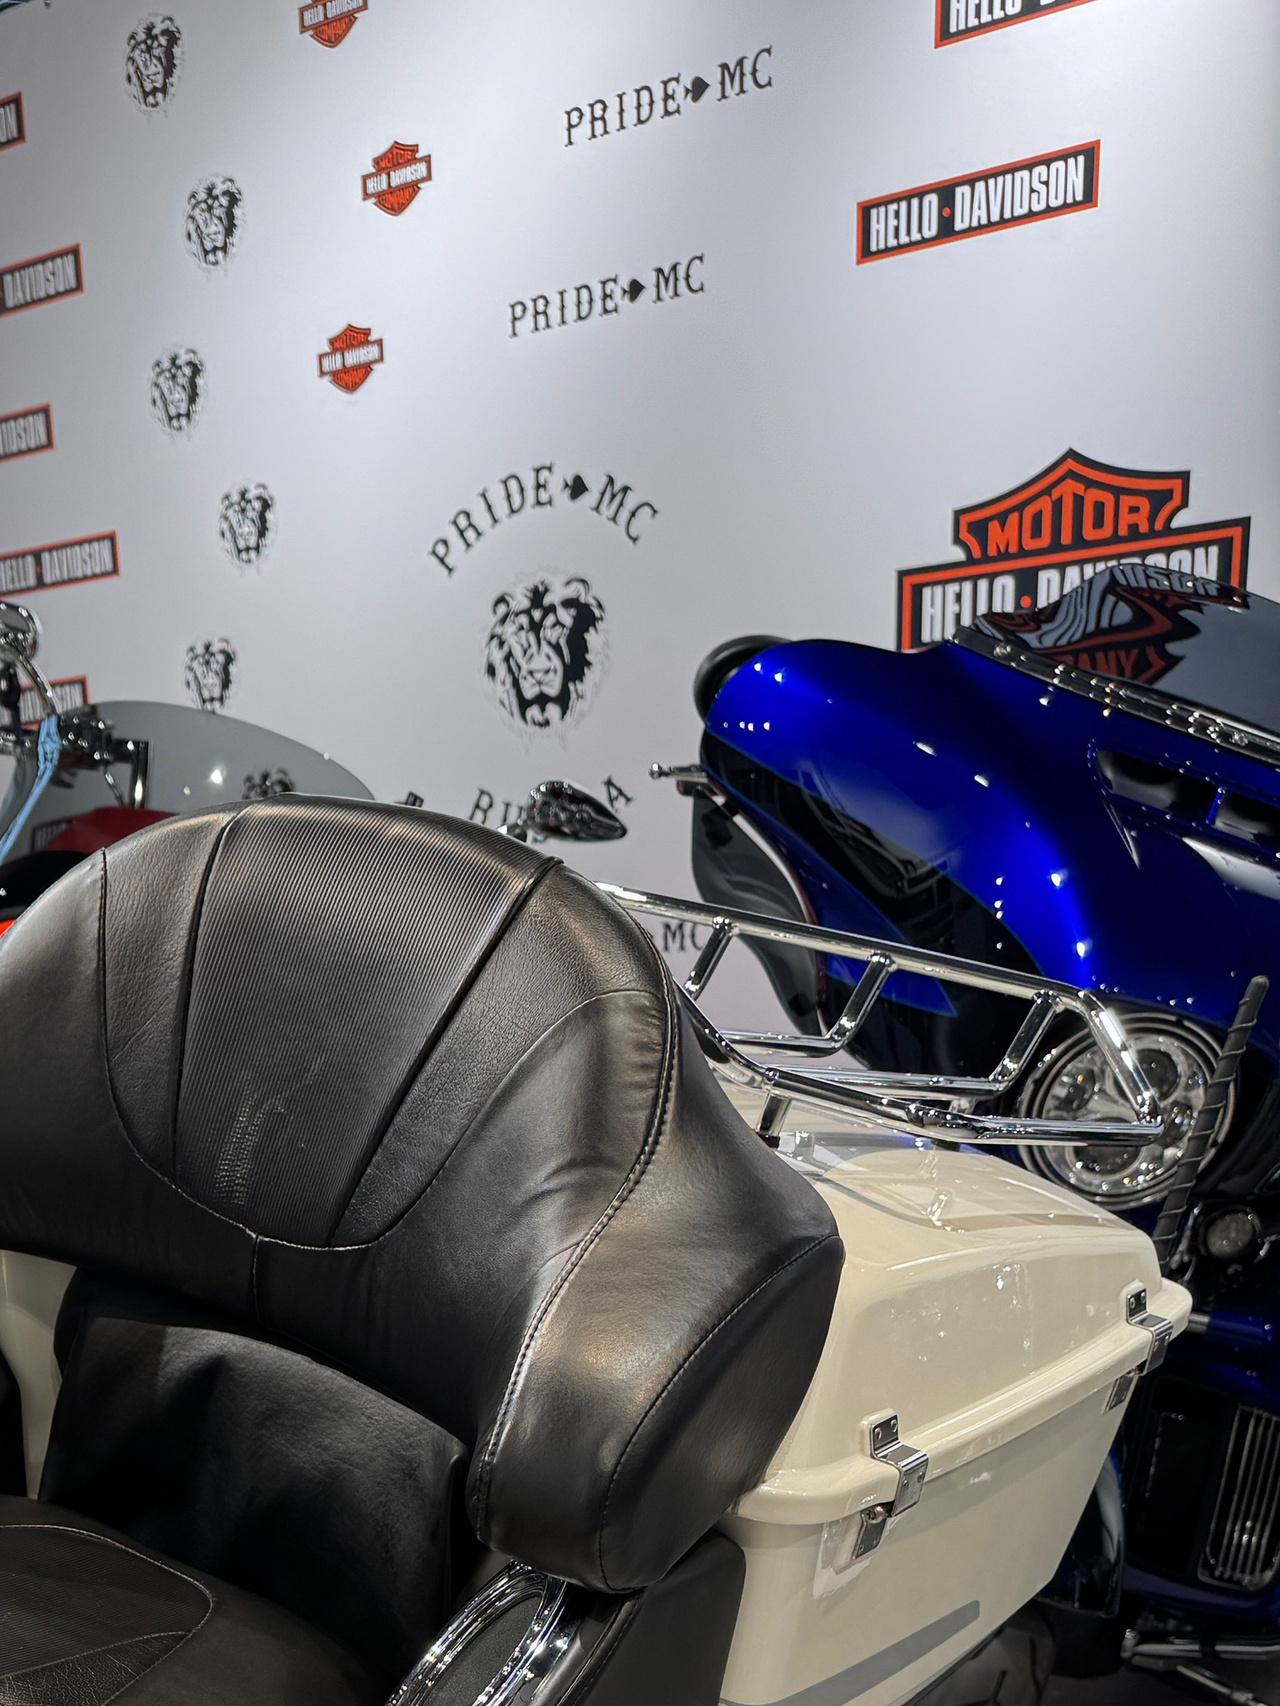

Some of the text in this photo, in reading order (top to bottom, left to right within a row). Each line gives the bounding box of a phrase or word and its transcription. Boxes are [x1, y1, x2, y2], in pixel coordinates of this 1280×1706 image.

[564, 44, 773, 147] PRIDE MC
[870, 155, 1085, 252] HELLO DAVIDSON
[3, 254, 78, 308] DAVIDSON
[509, 252, 705, 338] PRIDE MC
[427, 461, 659, 578] PRIDE MC
[987, 478, 1151, 557] MOTOR
[41, 538, 114, 584] DAVIDSON
